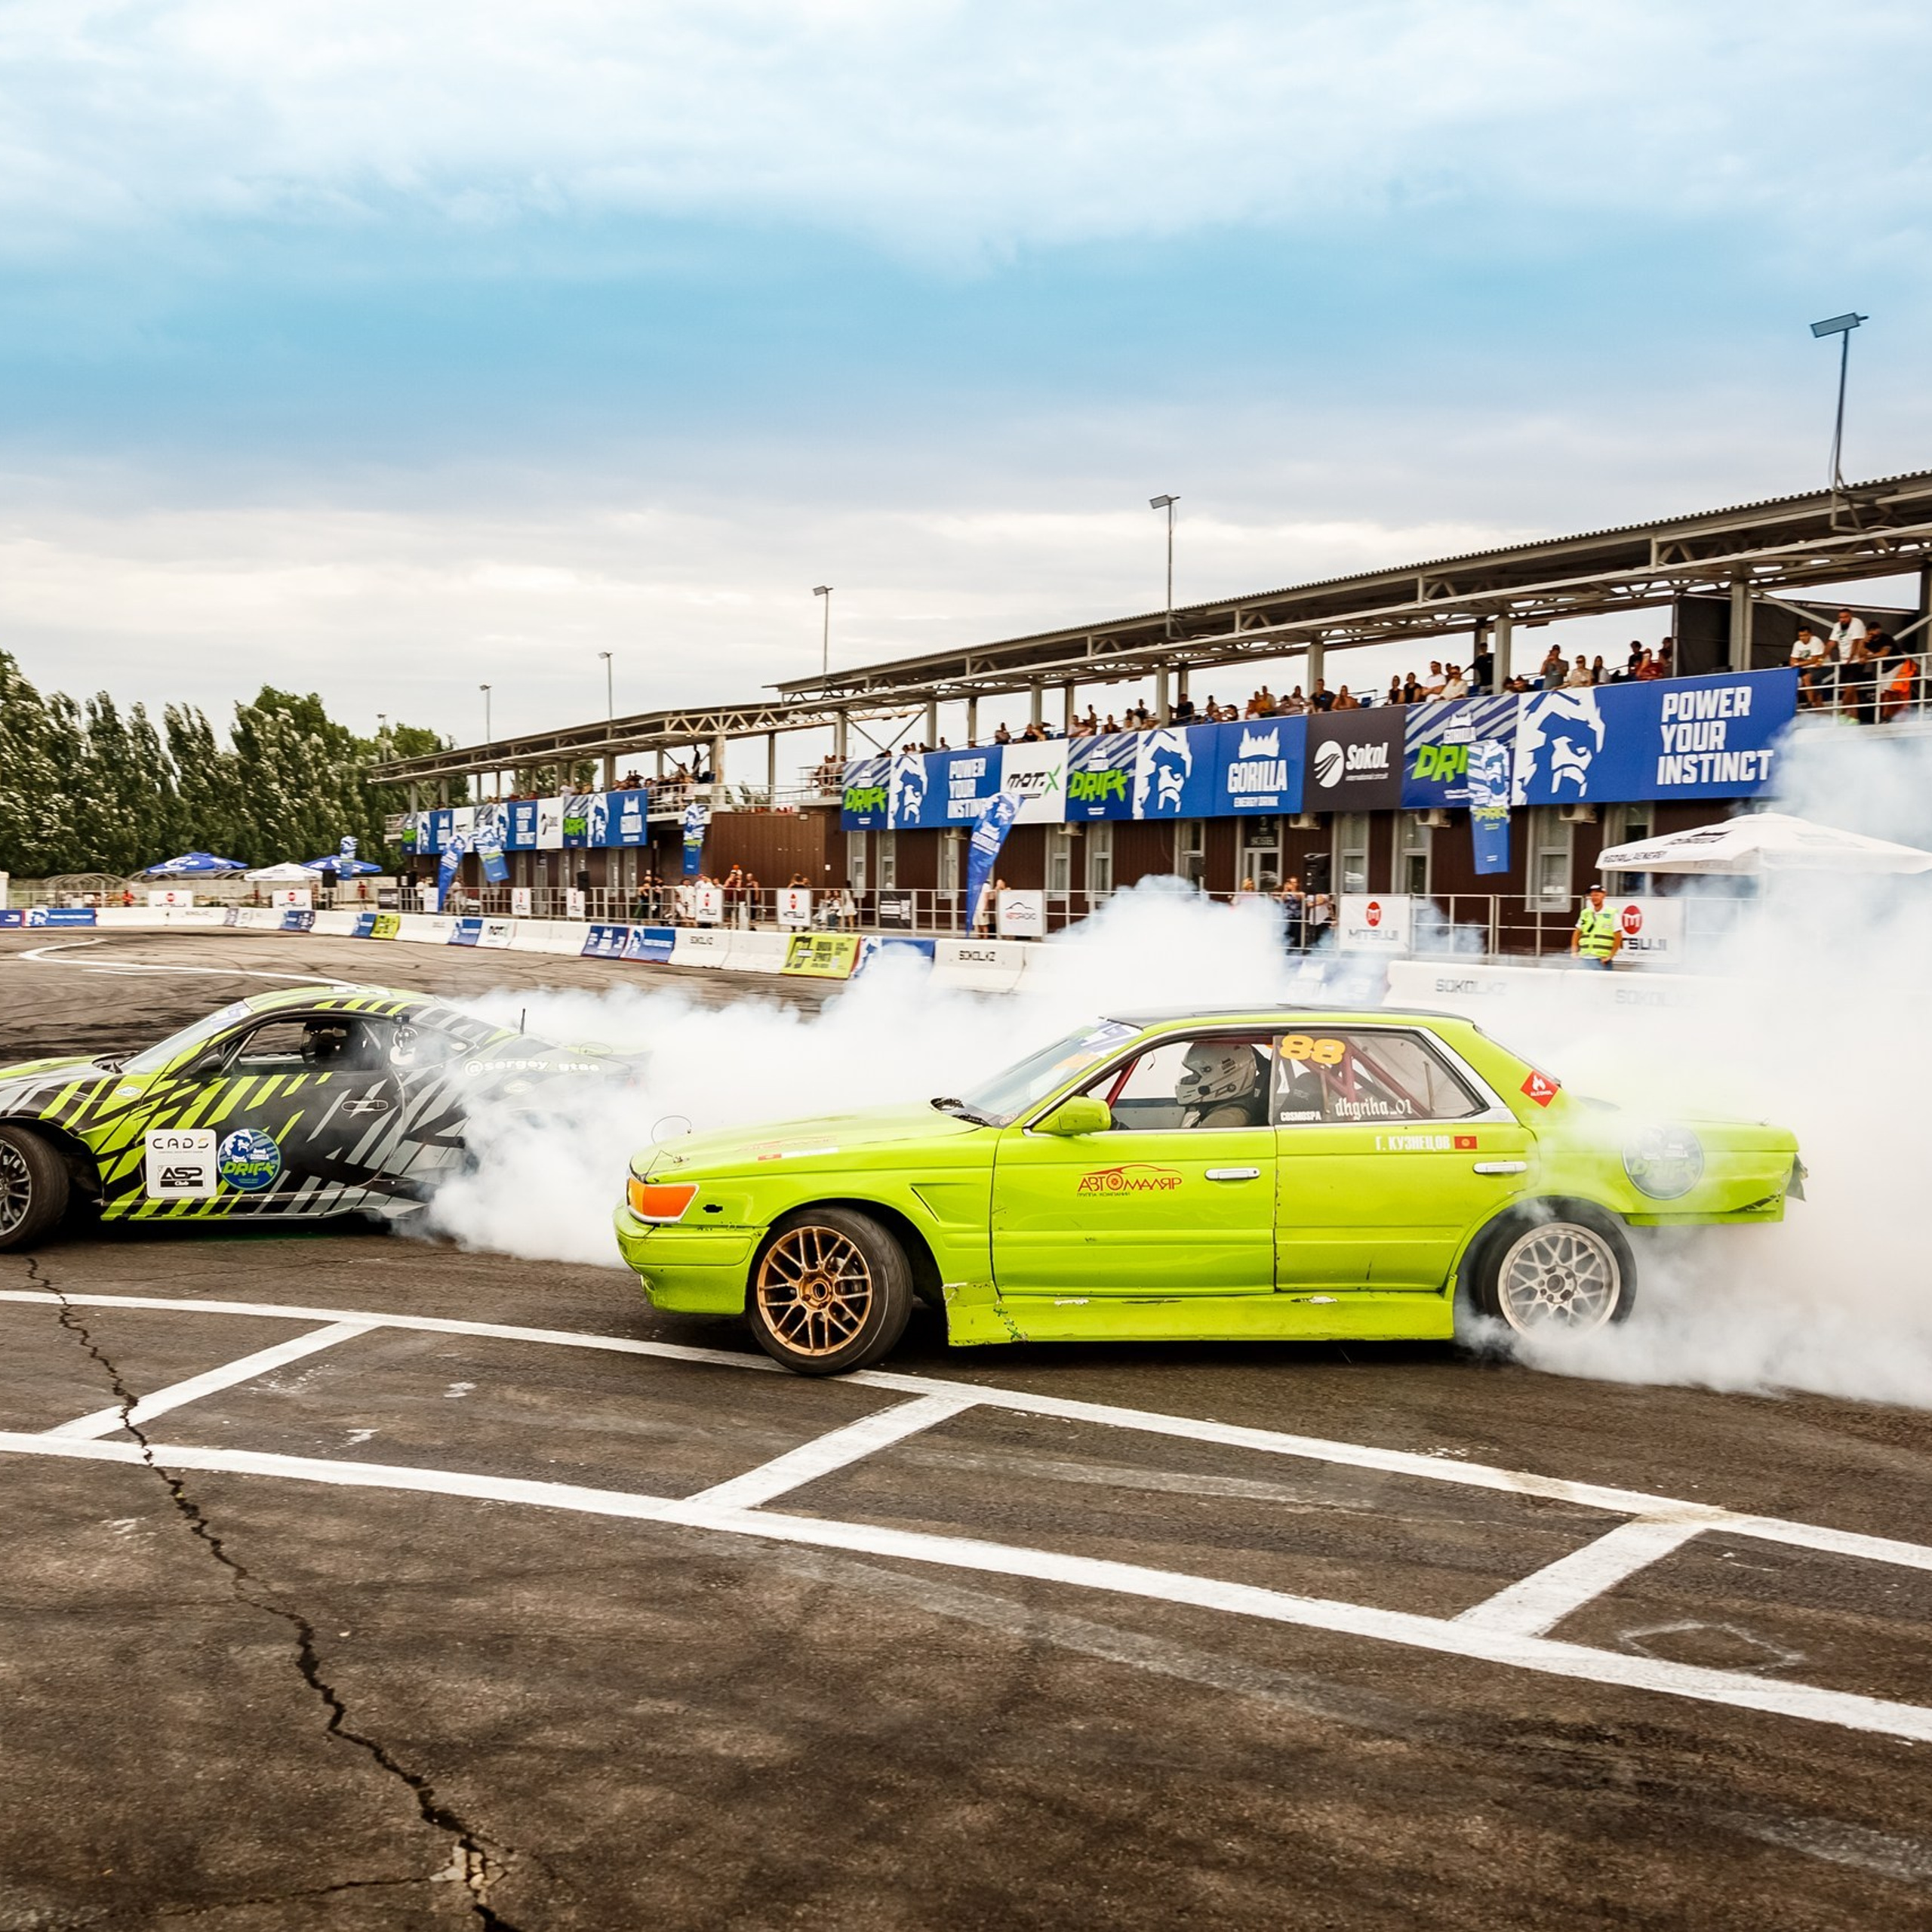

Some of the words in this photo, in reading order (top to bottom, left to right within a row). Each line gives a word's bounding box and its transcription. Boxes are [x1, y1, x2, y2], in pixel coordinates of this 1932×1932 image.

[1662, 686, 1752, 722] POWER
[1660, 720, 1727, 754] YOUR
[1227, 759, 1287, 793] GORILLA
[1411, 744, 1469, 783] DRI
[1656, 749, 1774, 786] INSTINCT
[1279, 1034, 1346, 1065] 88
[152, 1137, 209, 1149] CADS
[1389, 1136, 1451, 1152] КУЗНЕЦОВ
[160, 1167, 204, 1180] ASP
[222, 1161, 276, 1177] DRIFT
[1077, 1173, 1183, 1192] АВТОМАЛЯР
